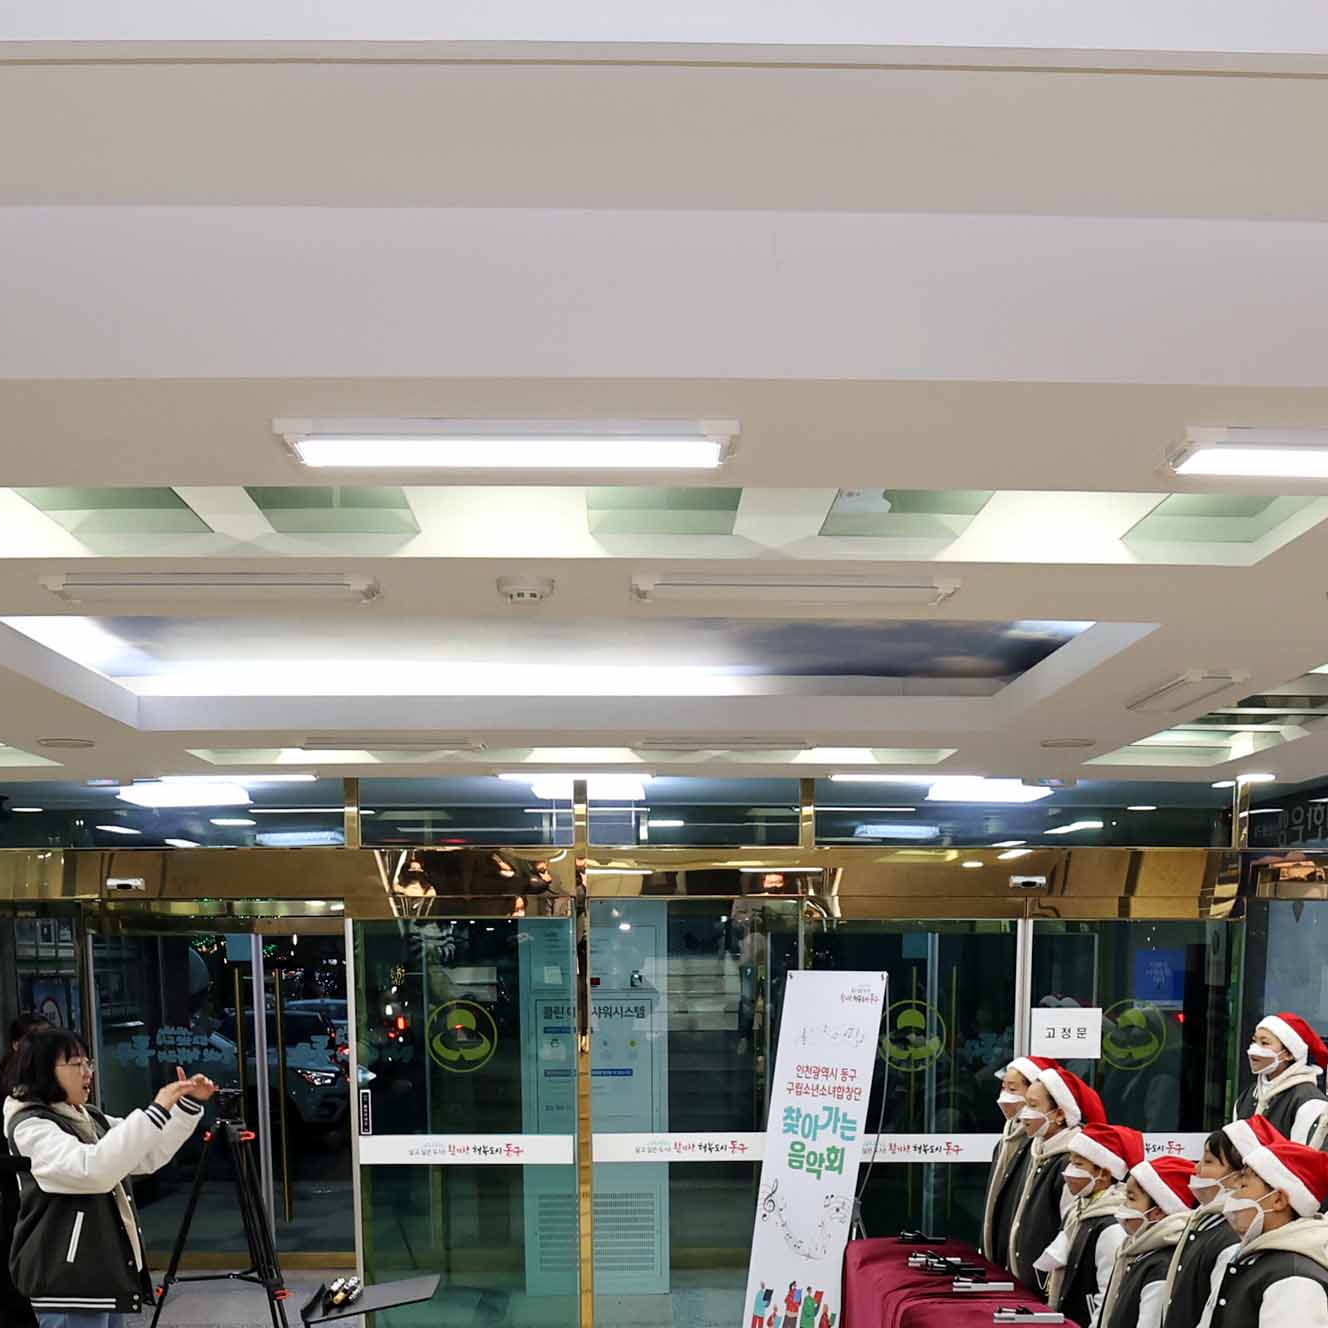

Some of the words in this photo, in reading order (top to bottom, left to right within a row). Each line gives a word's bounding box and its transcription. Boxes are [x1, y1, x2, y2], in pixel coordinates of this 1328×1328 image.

[543, 1006, 564, 1020] 클린
[795, 1063, 839, 1082] 인천광역시
[840, 1067, 857, 1083] 동구
[786, 1081, 863, 1102] 구립소년소녀합창단
[782, 1104, 857, 1142] 찾아가는
[503, 1142, 524, 1157] 동구
[729, 1140, 749, 1154] 동구
[943, 1141, 964, 1155] 동구
[1166, 1140, 1185, 1154] 동구
[788, 1140, 846, 1180] 음악회
